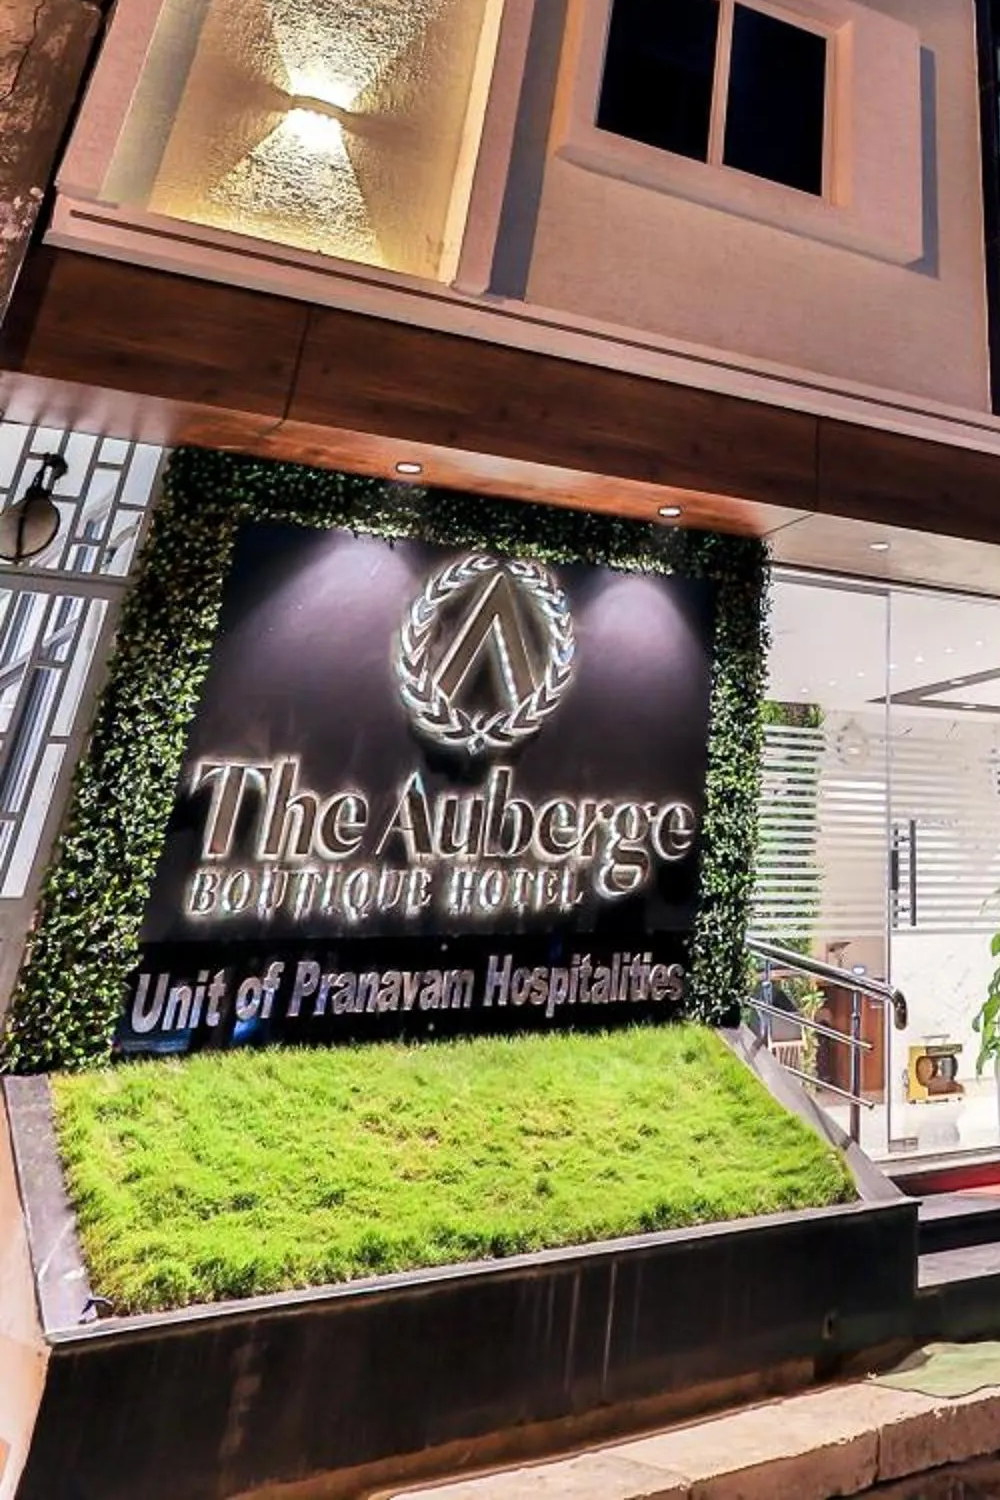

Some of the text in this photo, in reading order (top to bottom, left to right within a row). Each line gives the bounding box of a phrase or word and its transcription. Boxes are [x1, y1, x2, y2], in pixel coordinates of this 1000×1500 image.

[192, 757, 696, 896] The Auberge
[189, 868, 584, 916] BOUTIQUE HOTEL
[131, 951, 684, 1034] Unit of Pranavam Hospitalities
